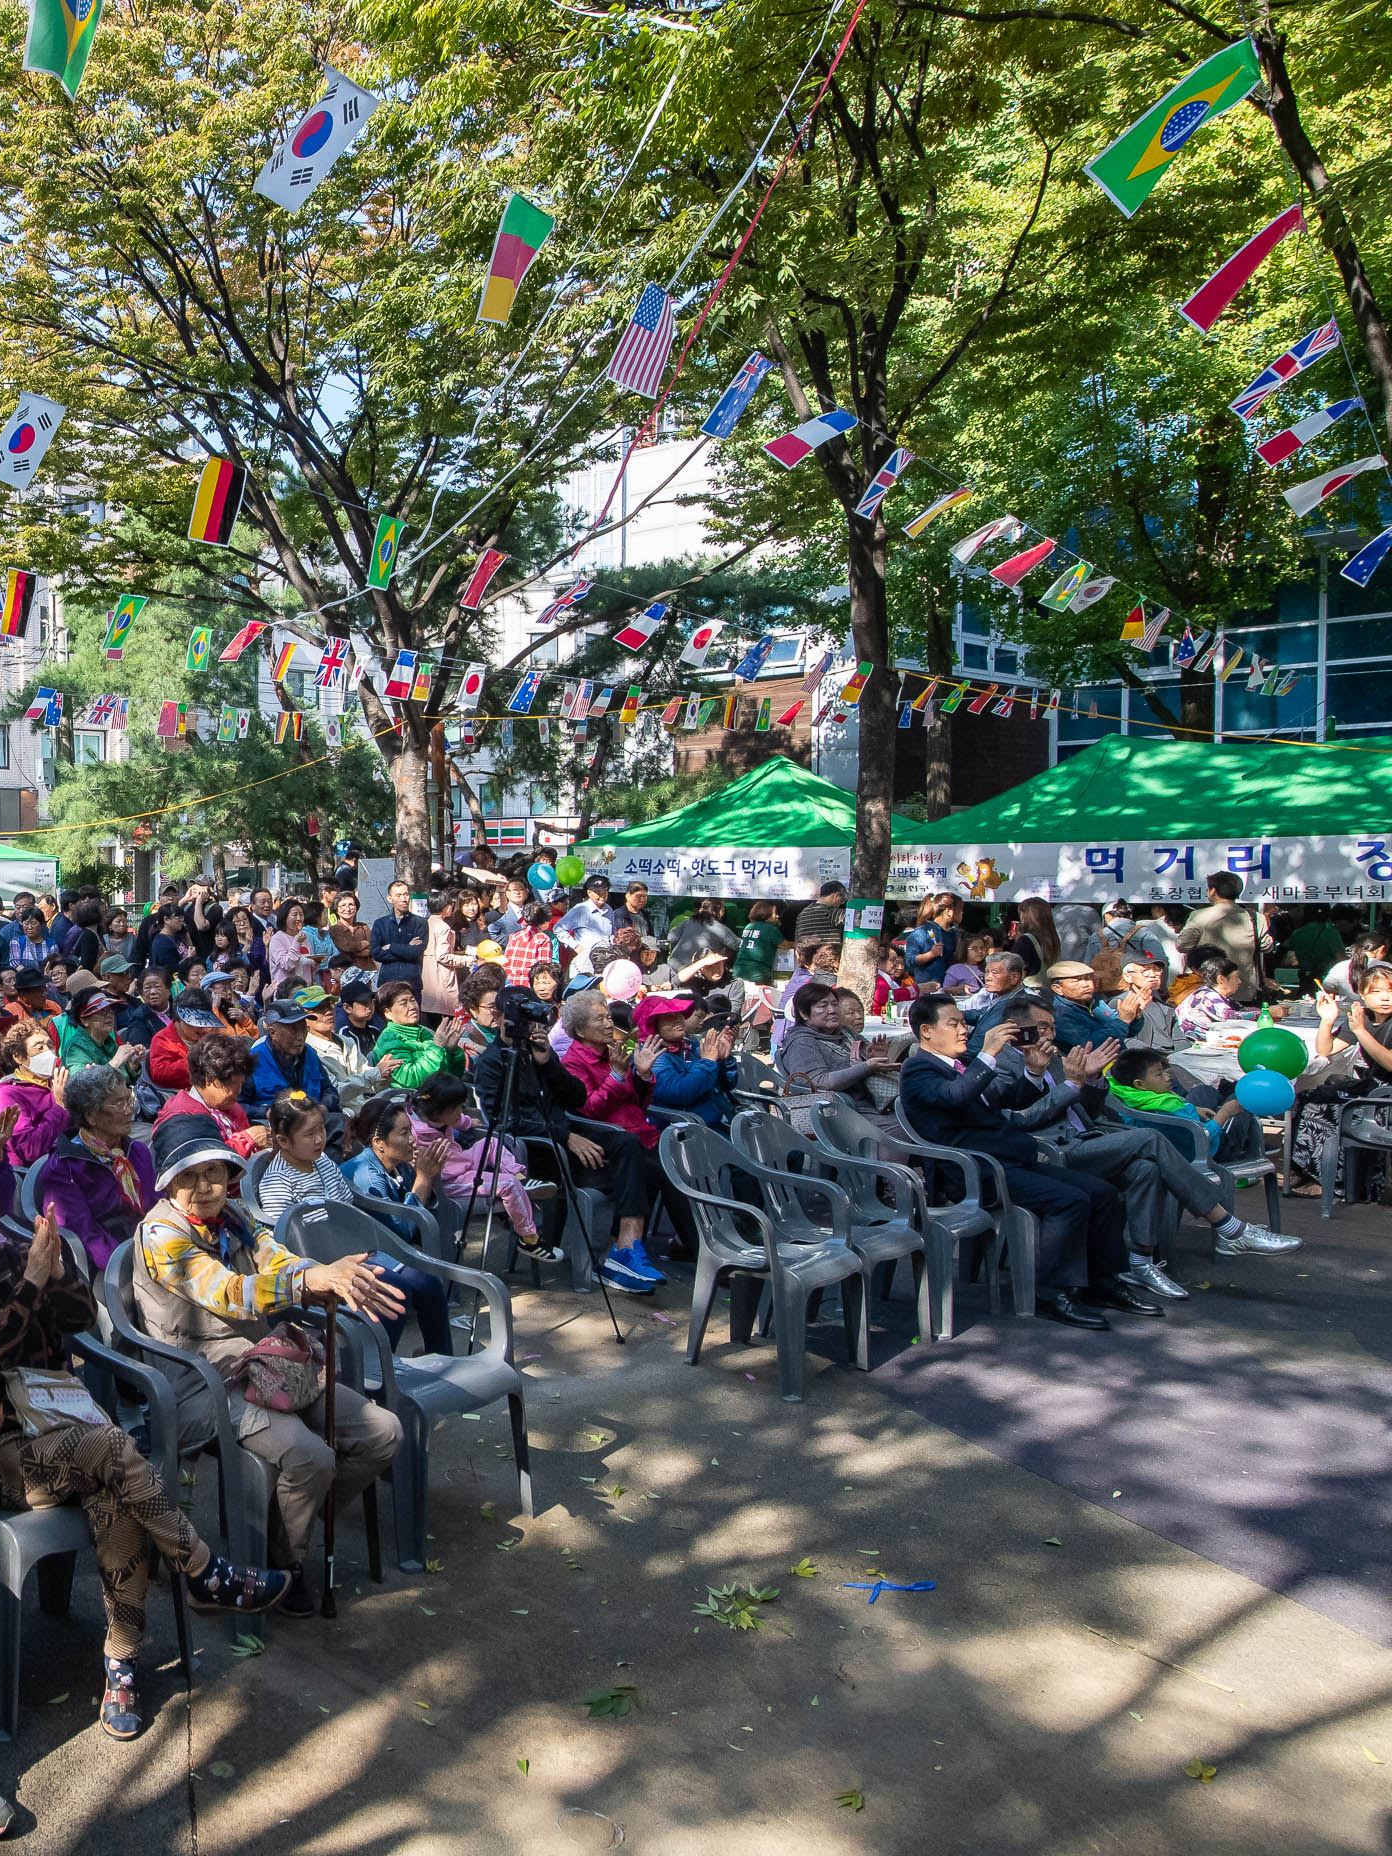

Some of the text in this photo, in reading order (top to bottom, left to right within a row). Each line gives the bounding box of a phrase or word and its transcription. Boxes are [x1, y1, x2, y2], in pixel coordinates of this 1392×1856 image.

[741, 859, 789, 879] 먹거리
[888, 867, 947, 879] 신만만 축제
[1085, 844, 1272, 884] 먹거리
[1262, 884, 1386, 900] 새마을부녀회
